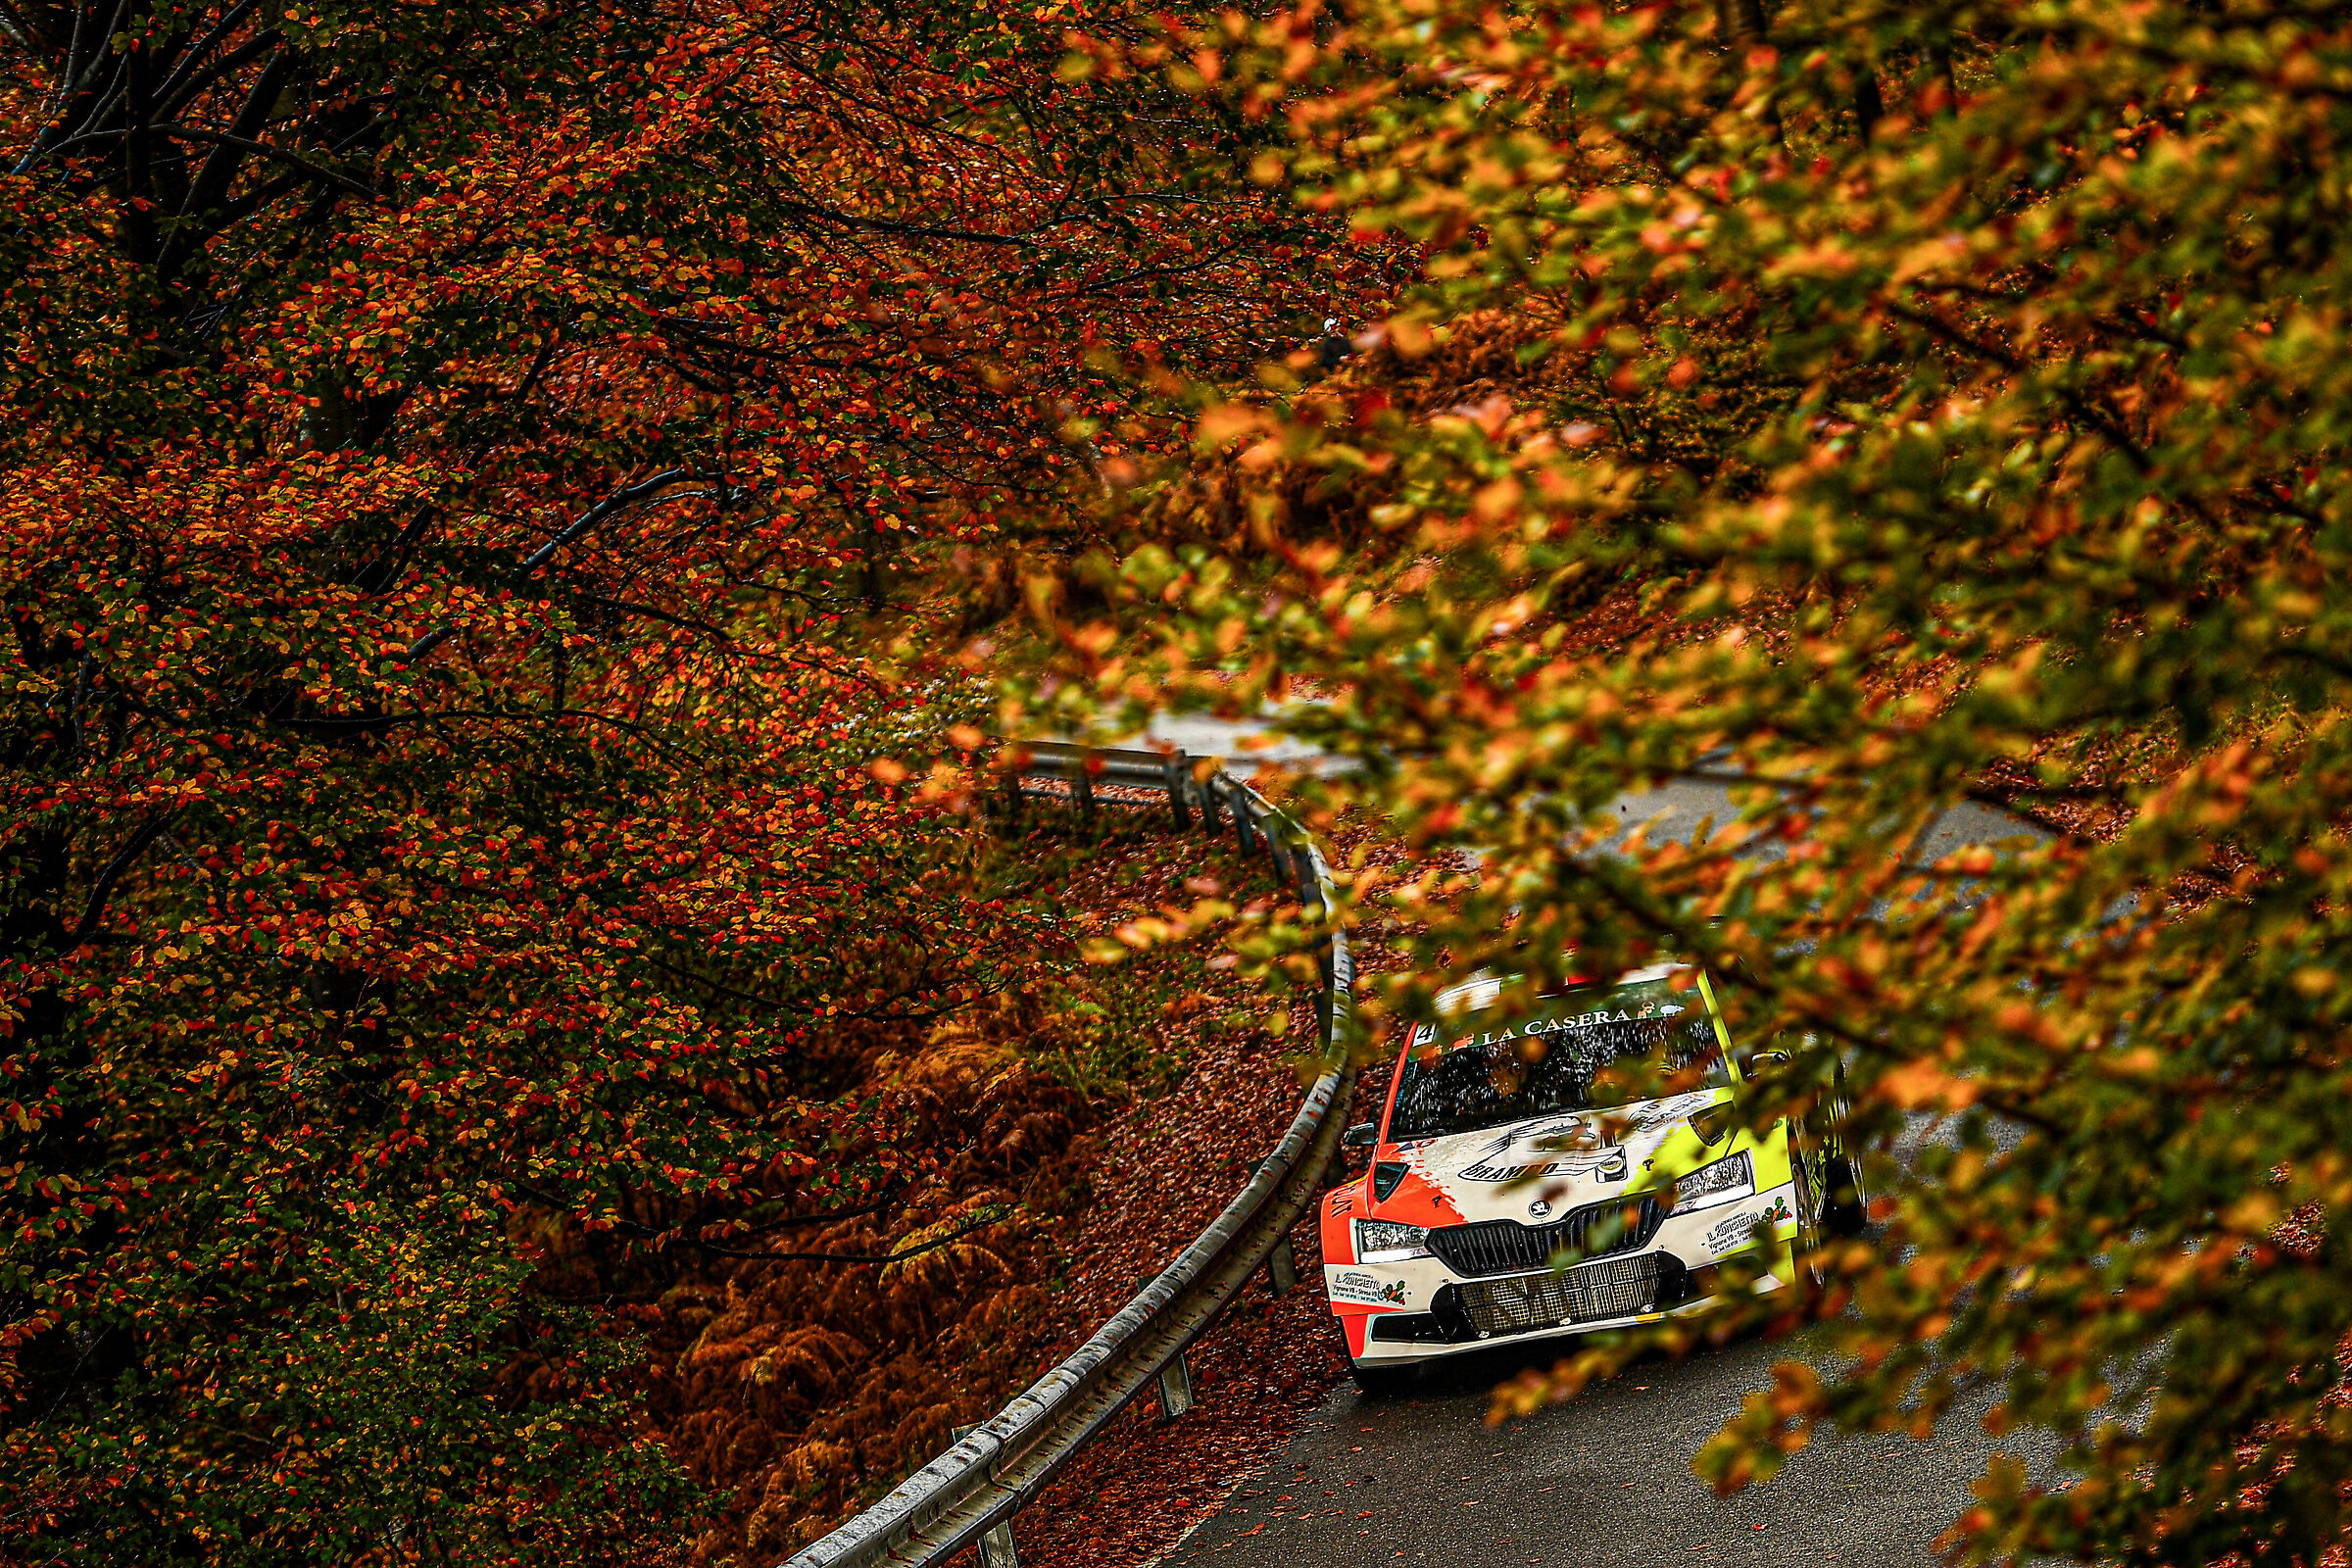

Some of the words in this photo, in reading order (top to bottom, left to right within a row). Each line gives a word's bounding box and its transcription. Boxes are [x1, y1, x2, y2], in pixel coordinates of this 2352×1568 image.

[1417, 1024, 1433, 1040] 4
[1482, 1027, 1517, 1046] LA
[1524, 1008, 1632, 1037] CASERA
